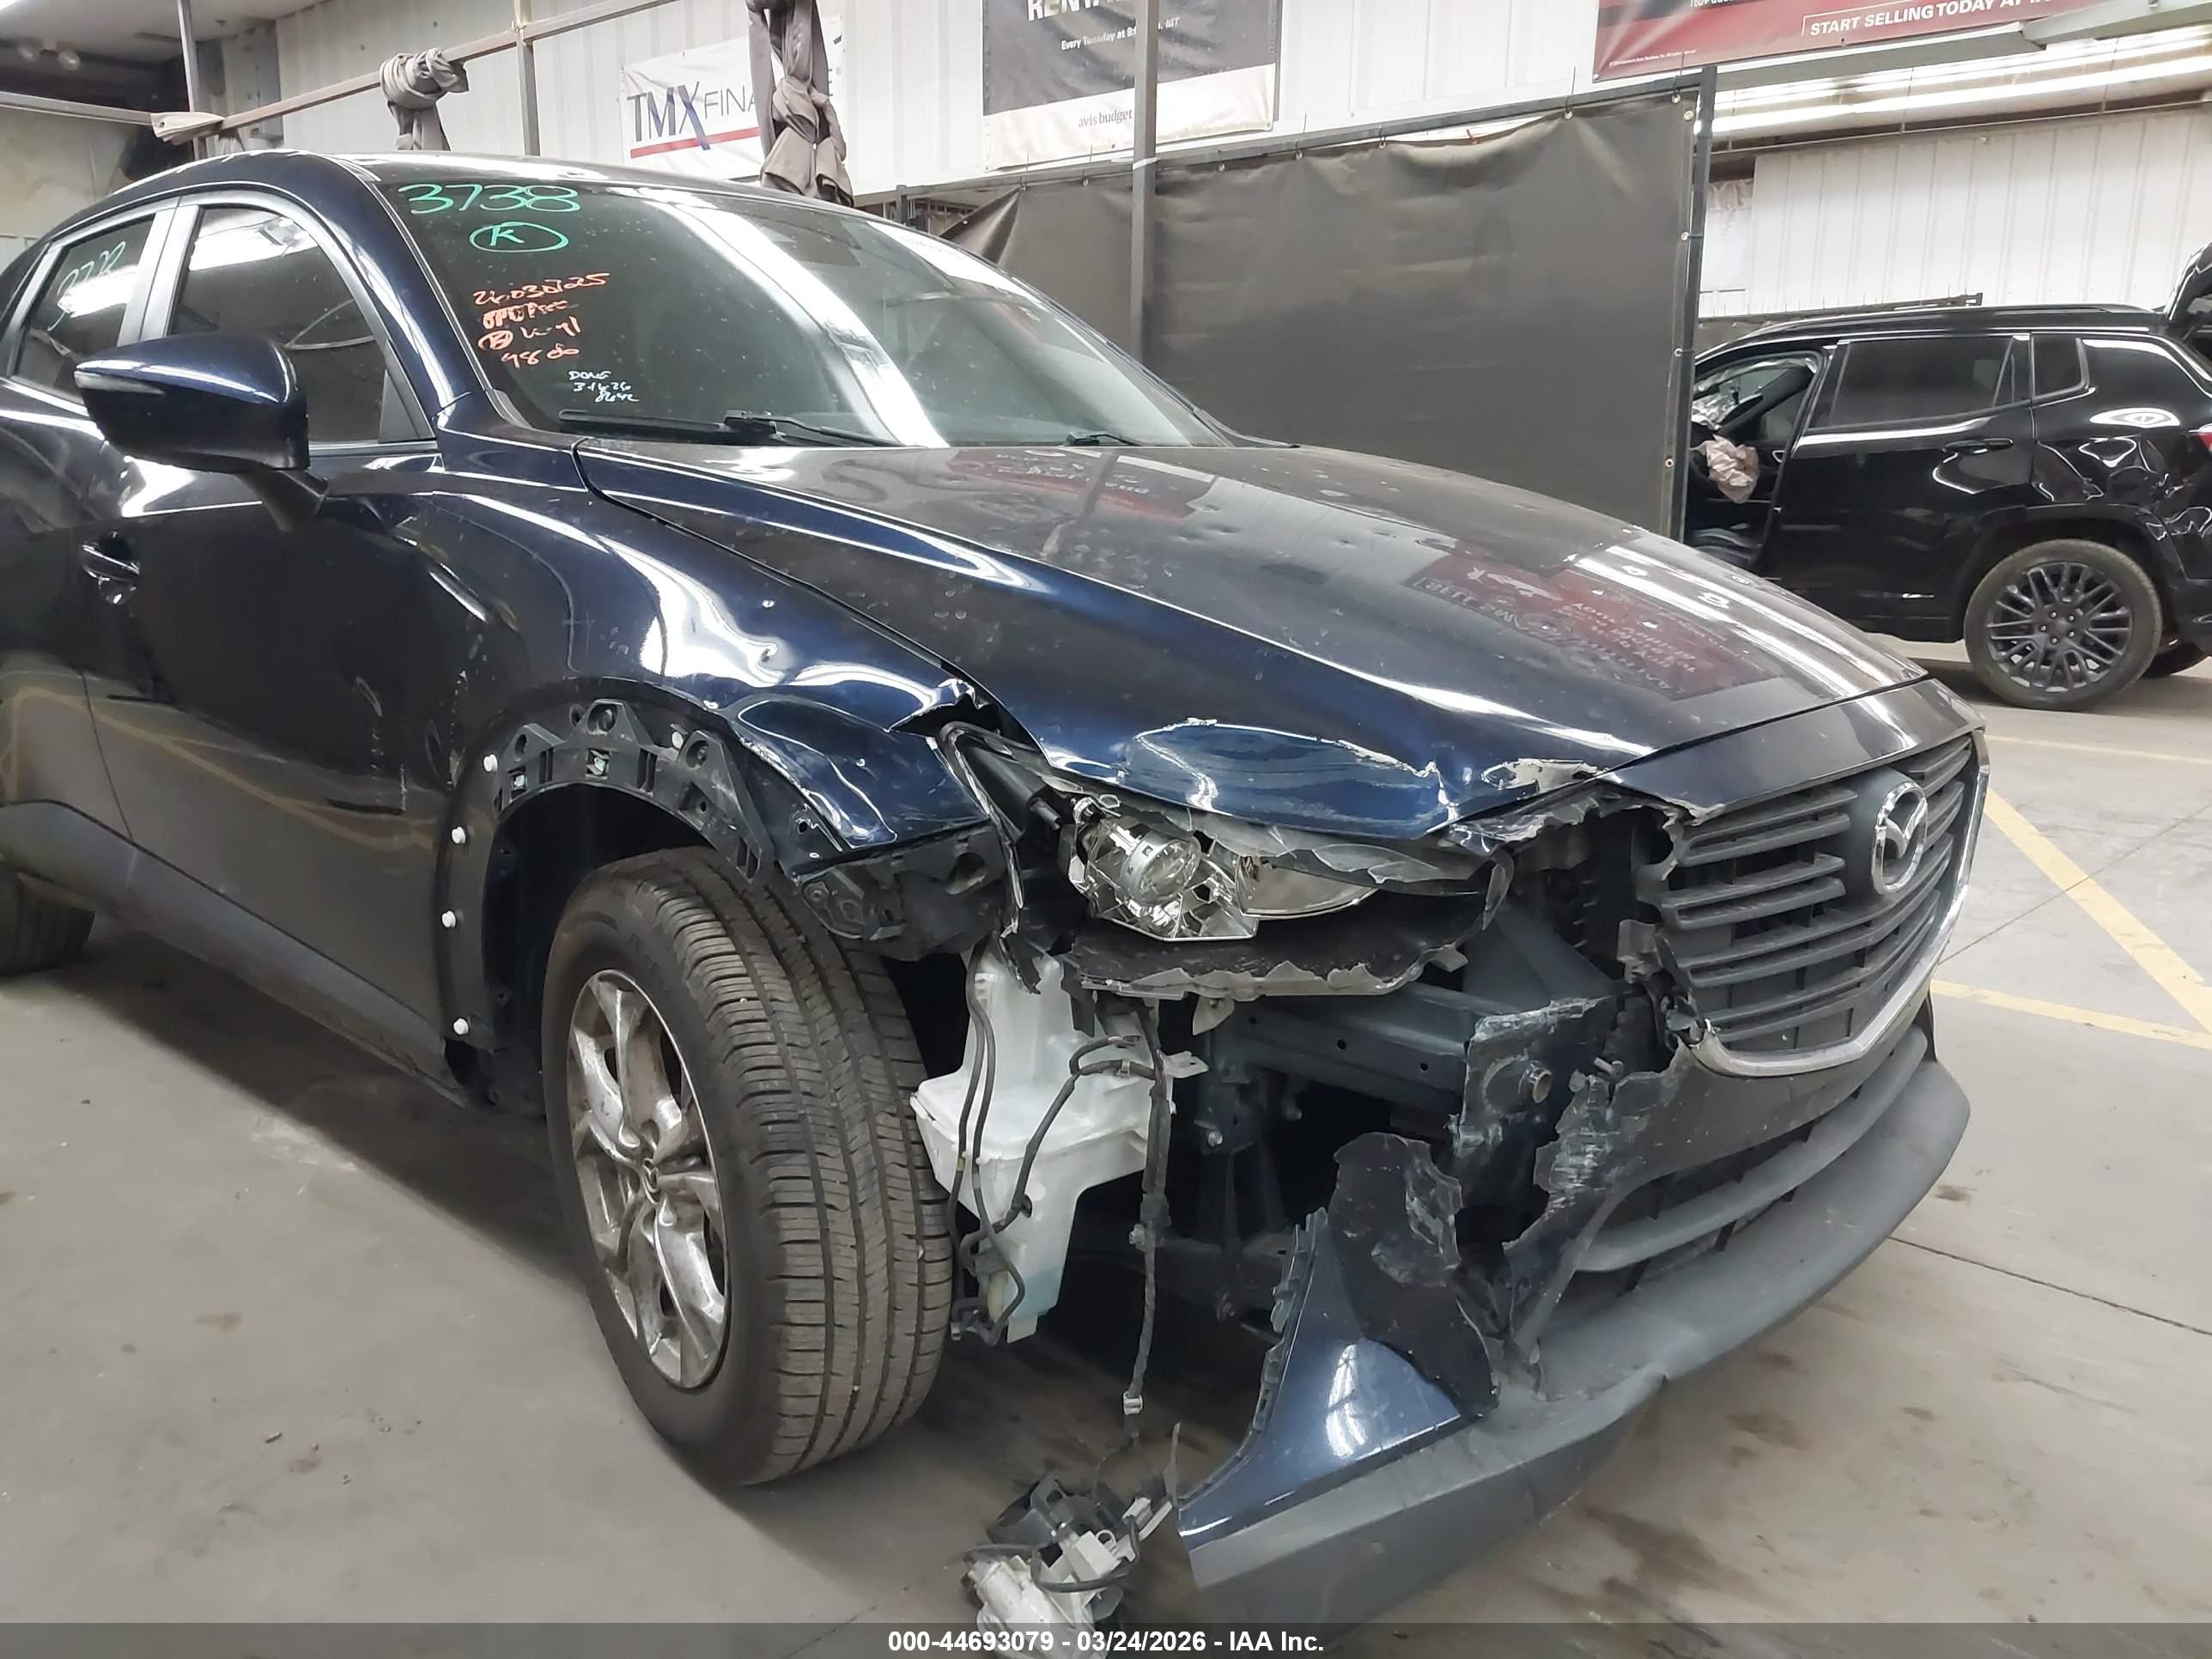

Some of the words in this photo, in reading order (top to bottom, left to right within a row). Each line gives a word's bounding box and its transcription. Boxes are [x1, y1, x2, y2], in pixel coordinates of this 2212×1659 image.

[1810, 16, 1861, 35] START
[1864, 4, 1933, 27] SELLING
[1937, 0, 1997, 17] TODAY
[1061, 40, 1081, 51] Every
[1083, 33, 1115, 46] Tuesday
[1117, 28, 1125, 40] at
[626, 81, 711, 151] TMX
[398, 184, 580, 215] 3738
